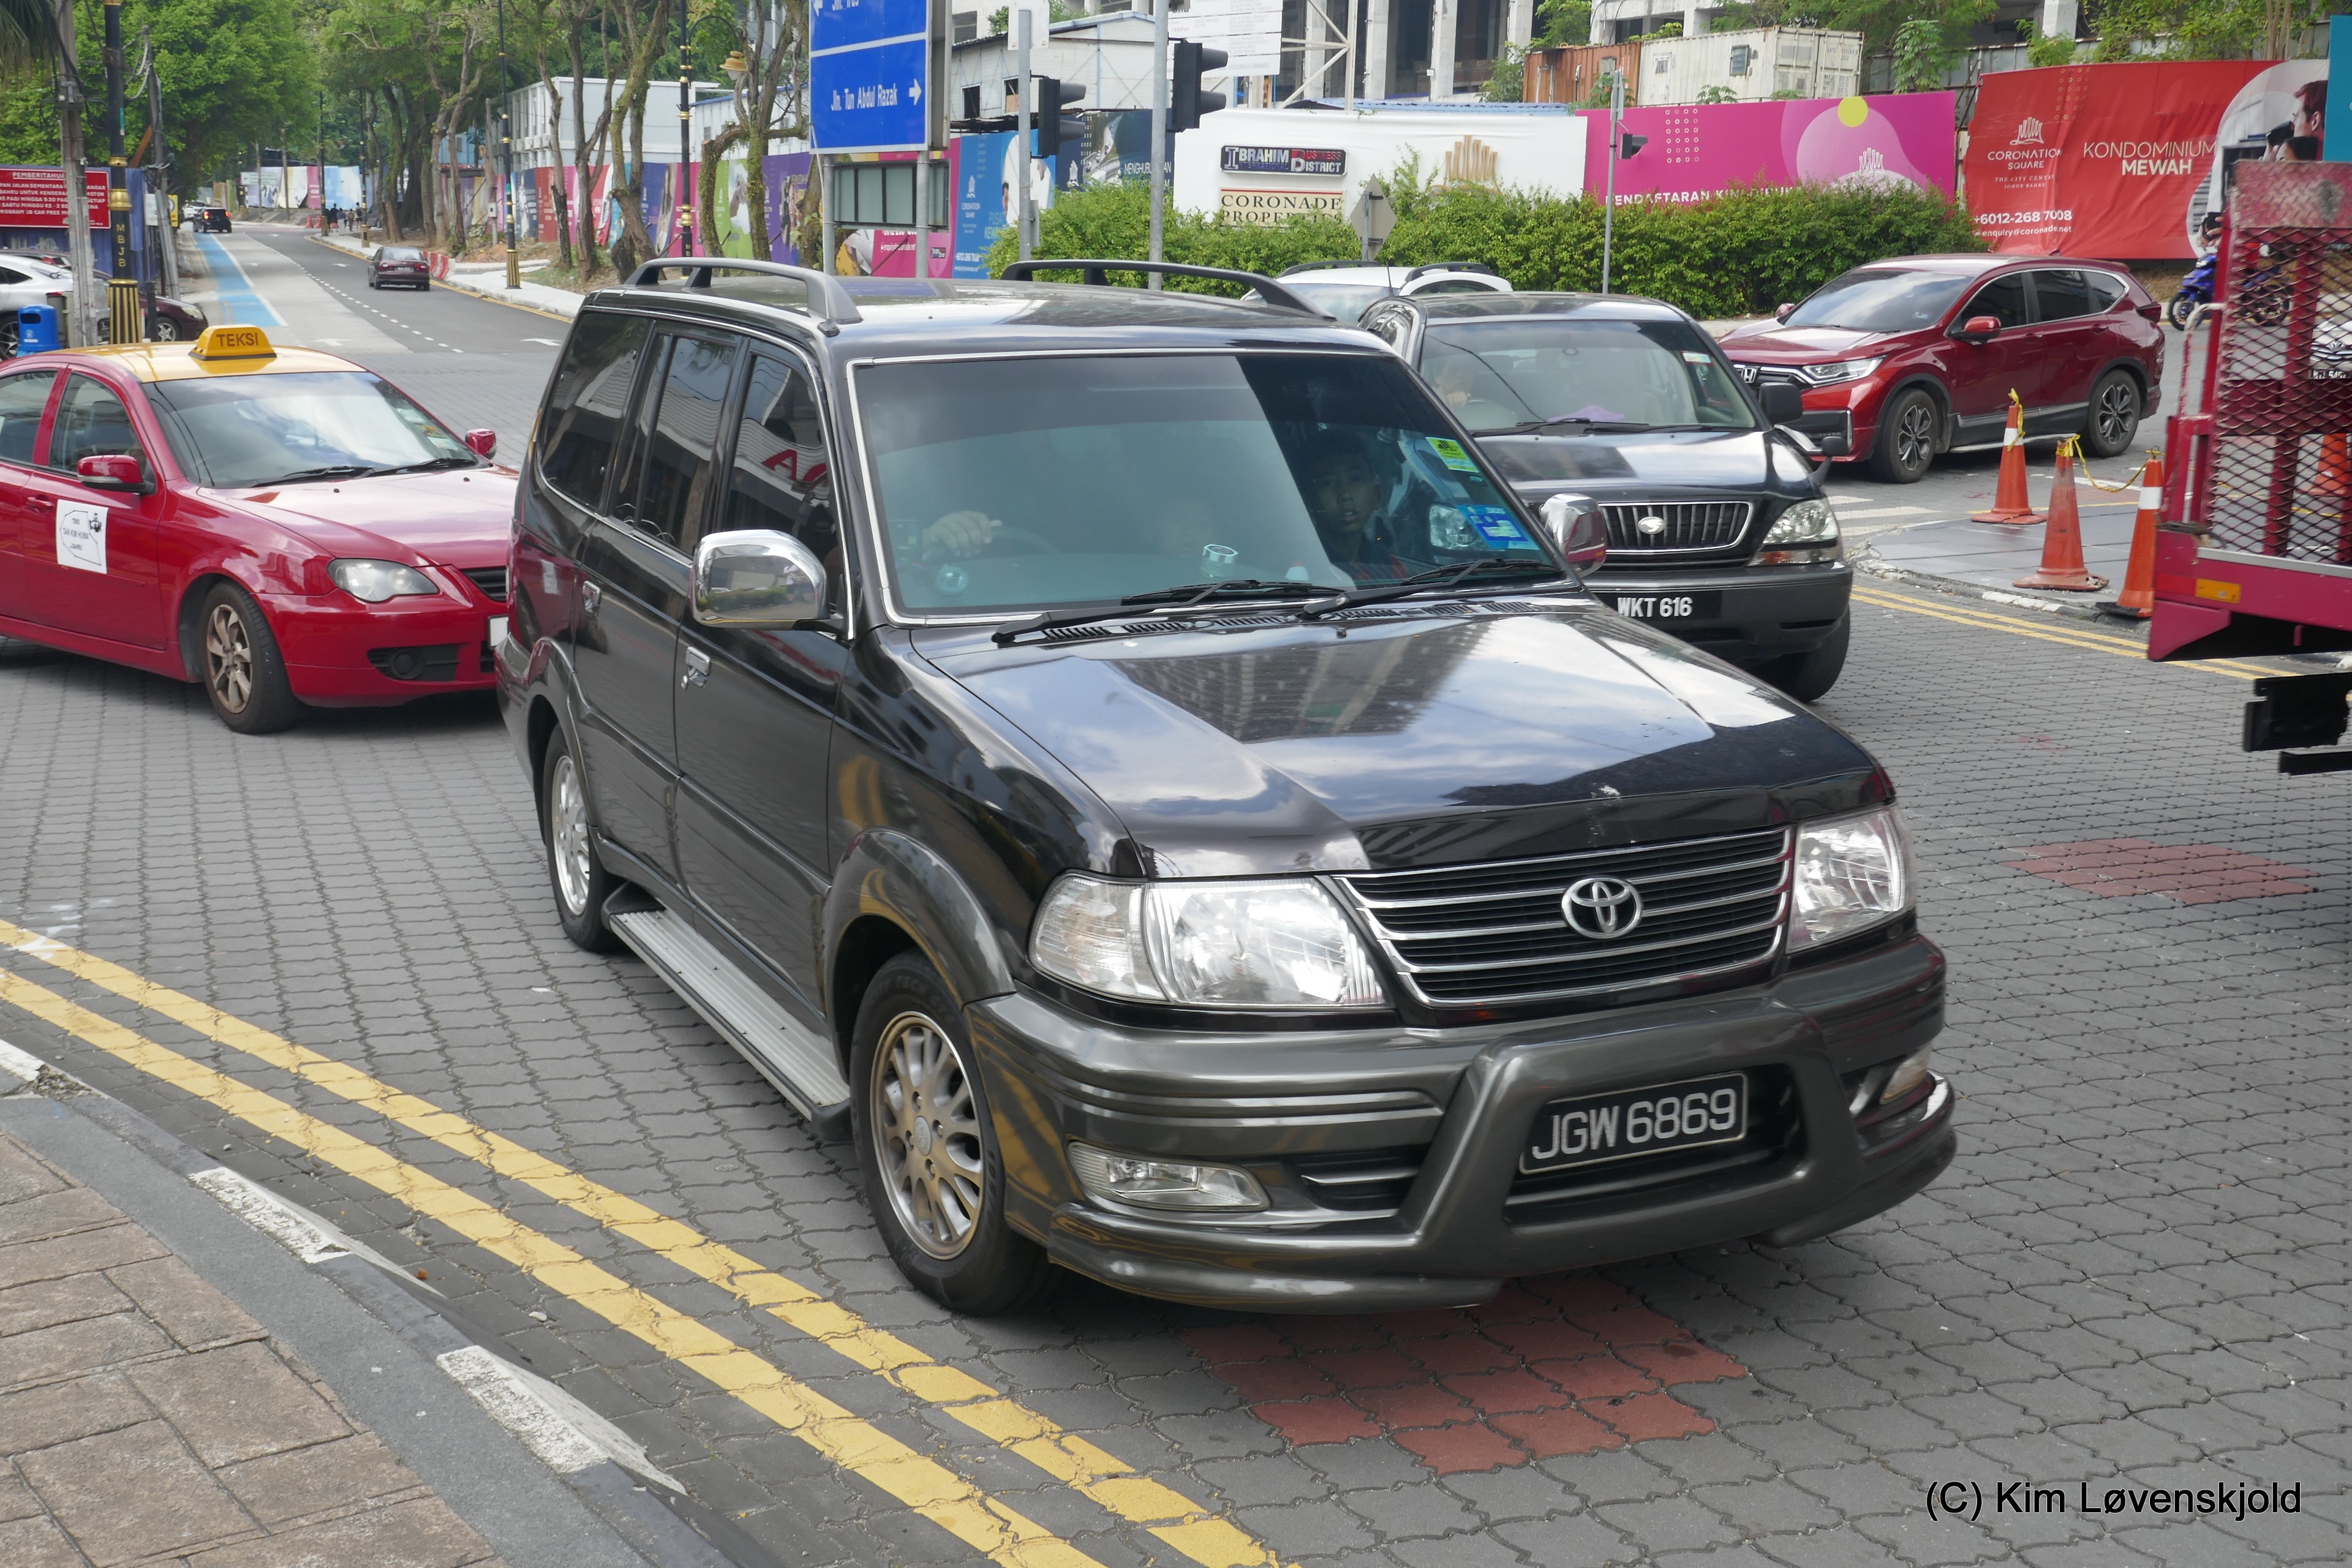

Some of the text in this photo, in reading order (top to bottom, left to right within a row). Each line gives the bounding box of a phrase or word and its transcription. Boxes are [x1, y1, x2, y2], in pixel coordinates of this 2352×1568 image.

[831, 83, 898, 111] Jln. Tun Abdul Razak
[1224, 147, 1342, 165] IBRAHIM BUSINESS
[1988, 148, 2062, 160] CORONATION
[2083, 141, 2217, 159] KONDOMINIUM
[1124, 161, 1172, 175] MENGHUBUAN
[1291, 157, 1341, 173] DISTRICT
[2008, 160, 2045, 170] SQUARE
[2122, 159, 2193, 176] MEWAH
[1221, 195, 1343, 210] CORONADE
[1223, 211, 1342, 225] PROPEIS
[1973, 209, 2073, 225] +6012-268 7008
[1982, 225, 2072, 238] enquiry@coronade.net
[116, 224, 126, 267] MBJB
[216, 333, 258, 347] TEKSI
[1618, 597, 1692, 617] WKT 616
[1532, 1088, 1737, 1159] JGW 6869
